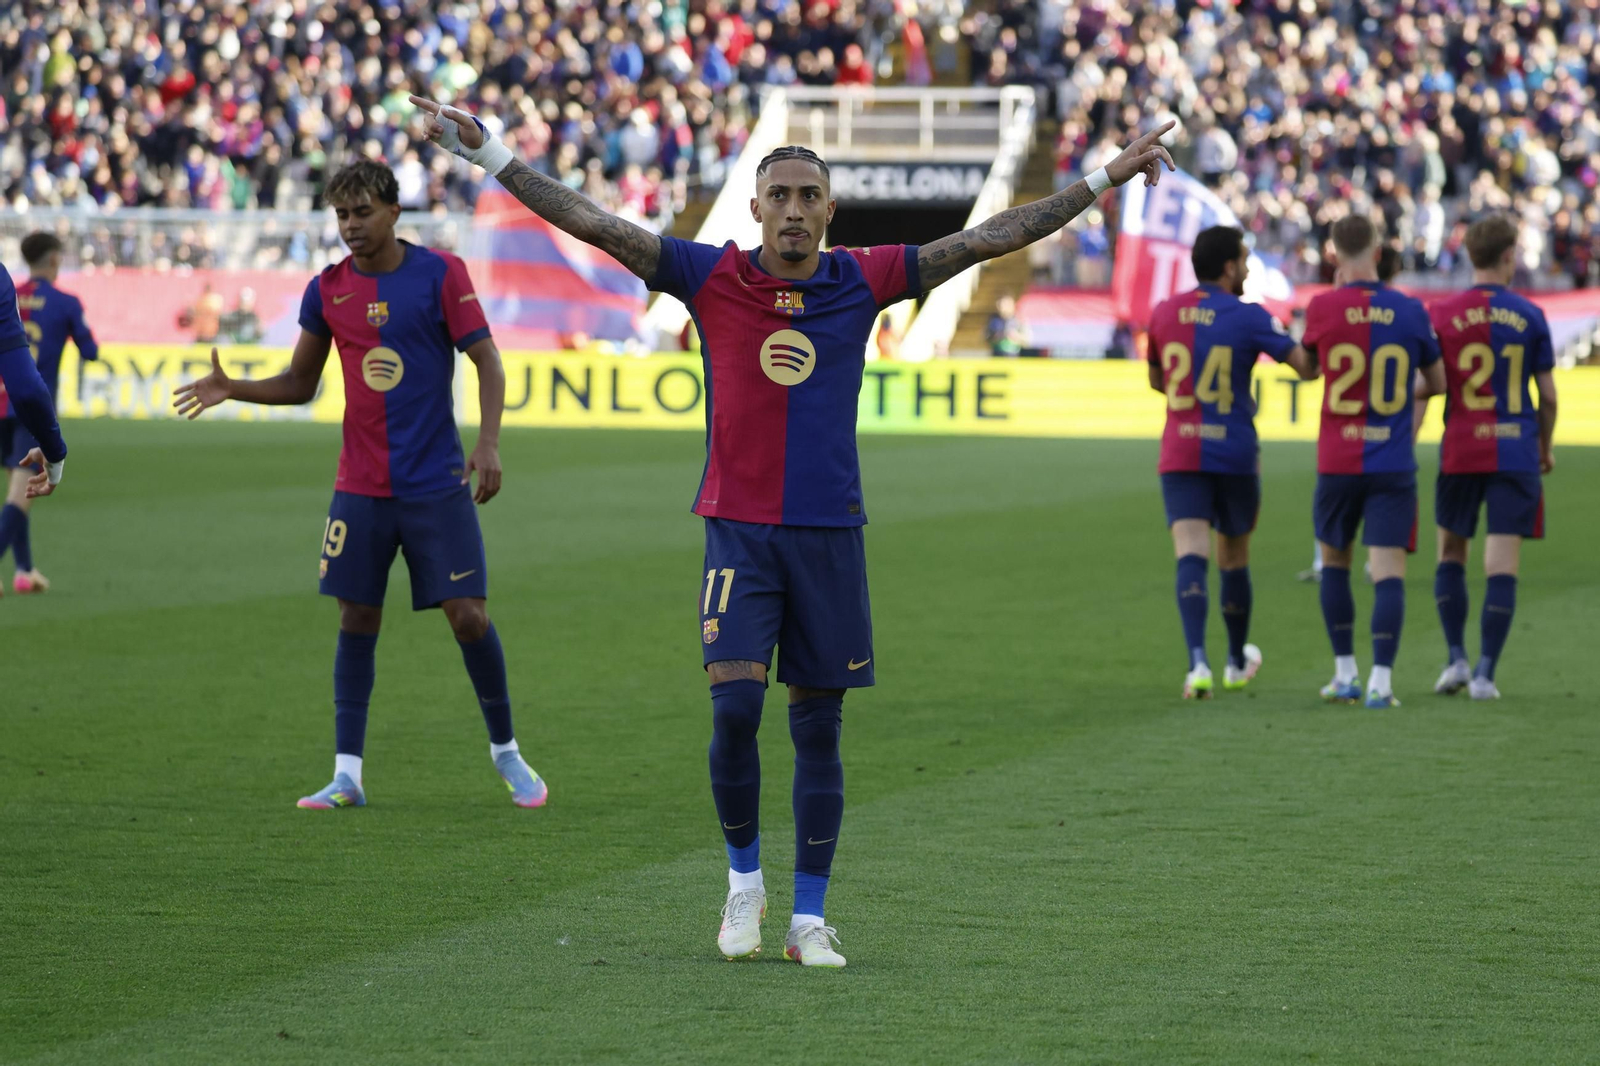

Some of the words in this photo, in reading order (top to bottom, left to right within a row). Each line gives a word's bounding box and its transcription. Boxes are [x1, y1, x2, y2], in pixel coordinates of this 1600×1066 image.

[1178, 307, 1216, 327] ERIC
[1344, 306, 1395, 326] OLMO
[864, 370, 1009, 420] THE
[1162, 341, 1234, 415] 24
[1327, 342, 1410, 416] 20
[1457, 342, 1525, 415] 21
[322, 516, 348, 558] 19
[703, 568, 735, 615] 11
